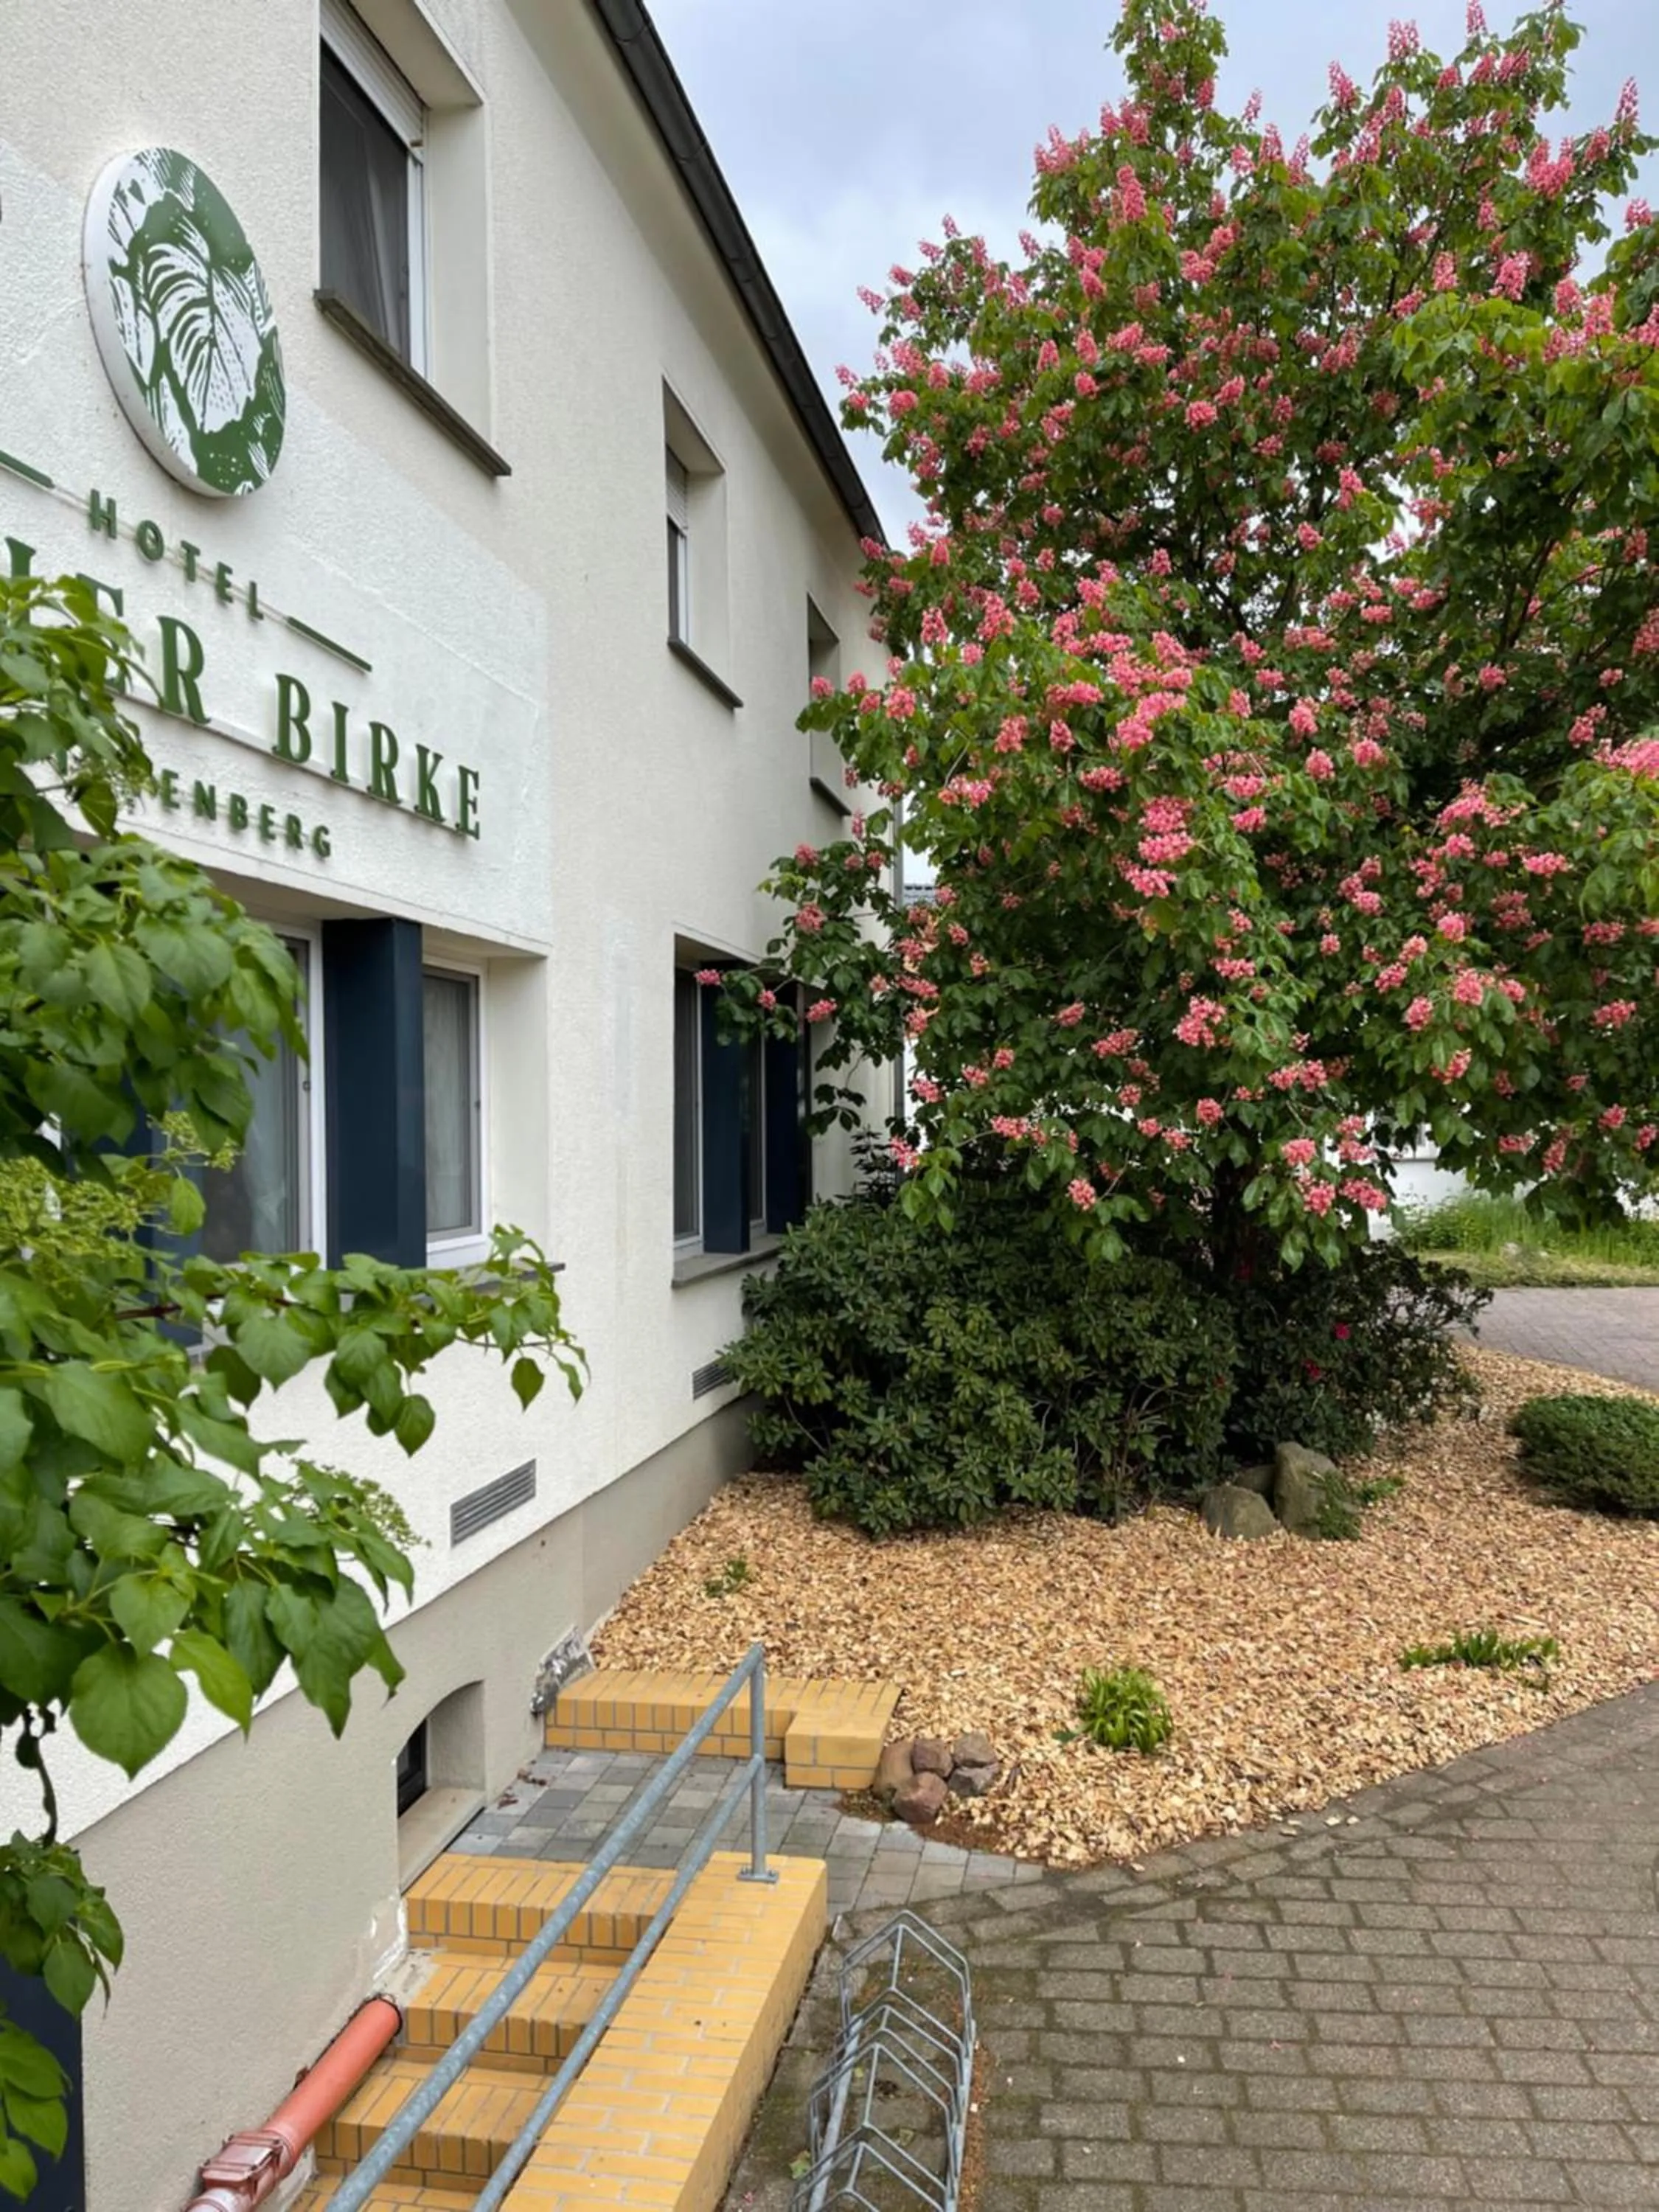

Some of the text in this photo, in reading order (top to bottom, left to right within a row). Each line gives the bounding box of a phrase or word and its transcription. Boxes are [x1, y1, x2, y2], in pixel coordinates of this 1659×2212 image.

[88, 488, 264, 621] HOTEL
[124, 768, 332, 860] ENBERG
[271, 672, 480, 841] BIRKE
